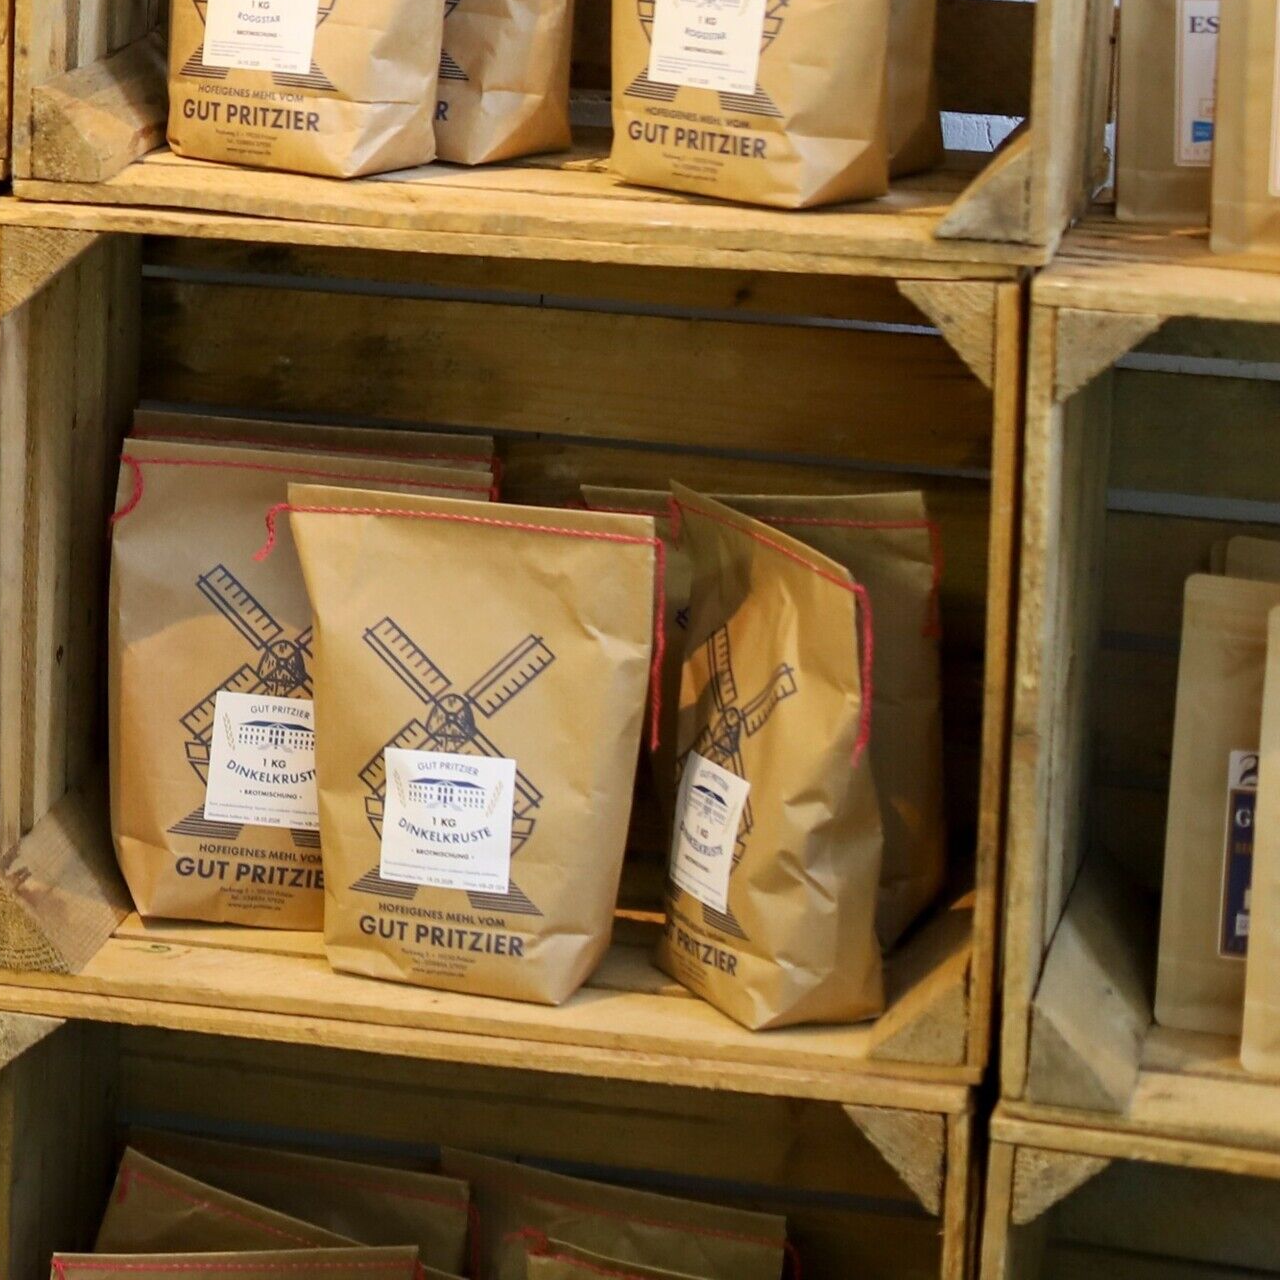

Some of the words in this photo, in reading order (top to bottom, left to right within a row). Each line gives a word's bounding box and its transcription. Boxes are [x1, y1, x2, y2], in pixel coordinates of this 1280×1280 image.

[237, 13, 281, 24] ROGGSTAR
[685, 28, 727, 41] ROGGSTAR
[199, 85, 250, 97] HOFEIGENES
[252, 90, 277, 100] MEHL
[279, 92, 304, 102] VOM
[183, 99, 221, 120] GUT
[226, 104, 320, 132] PRITZIER
[628, 120, 669, 145] GUT
[674, 127, 767, 159] PRITZIER
[251, 705, 269, 715] GUT
[272, 705, 311, 720] PRITZIER
[226, 760, 317, 785] DINKELKRUST
[417, 761, 436, 772] GUT
[439, 761, 479, 777] PRITZIER
[244, 789, 298, 801] BROTMISCHUNG
[398, 817, 492, 844] DINKELKRUSTE
[199, 844, 267, 859] HOFEIGENES
[269, 851, 297, 863] MEHL
[416, 849, 469, 860] BROTMISCHUNG
[175, 857, 229, 880] GUT
[236, 863, 325, 889] PRITZIE
[379, 903, 443, 920] HOFEIGENES
[446, 912, 475, 926] MEHL
[479, 917, 505, 928] VOM
[359, 915, 409, 941] GUT
[415, 924, 524, 958] PRITZIER
[676, 933, 738, 976] PRITZIER
